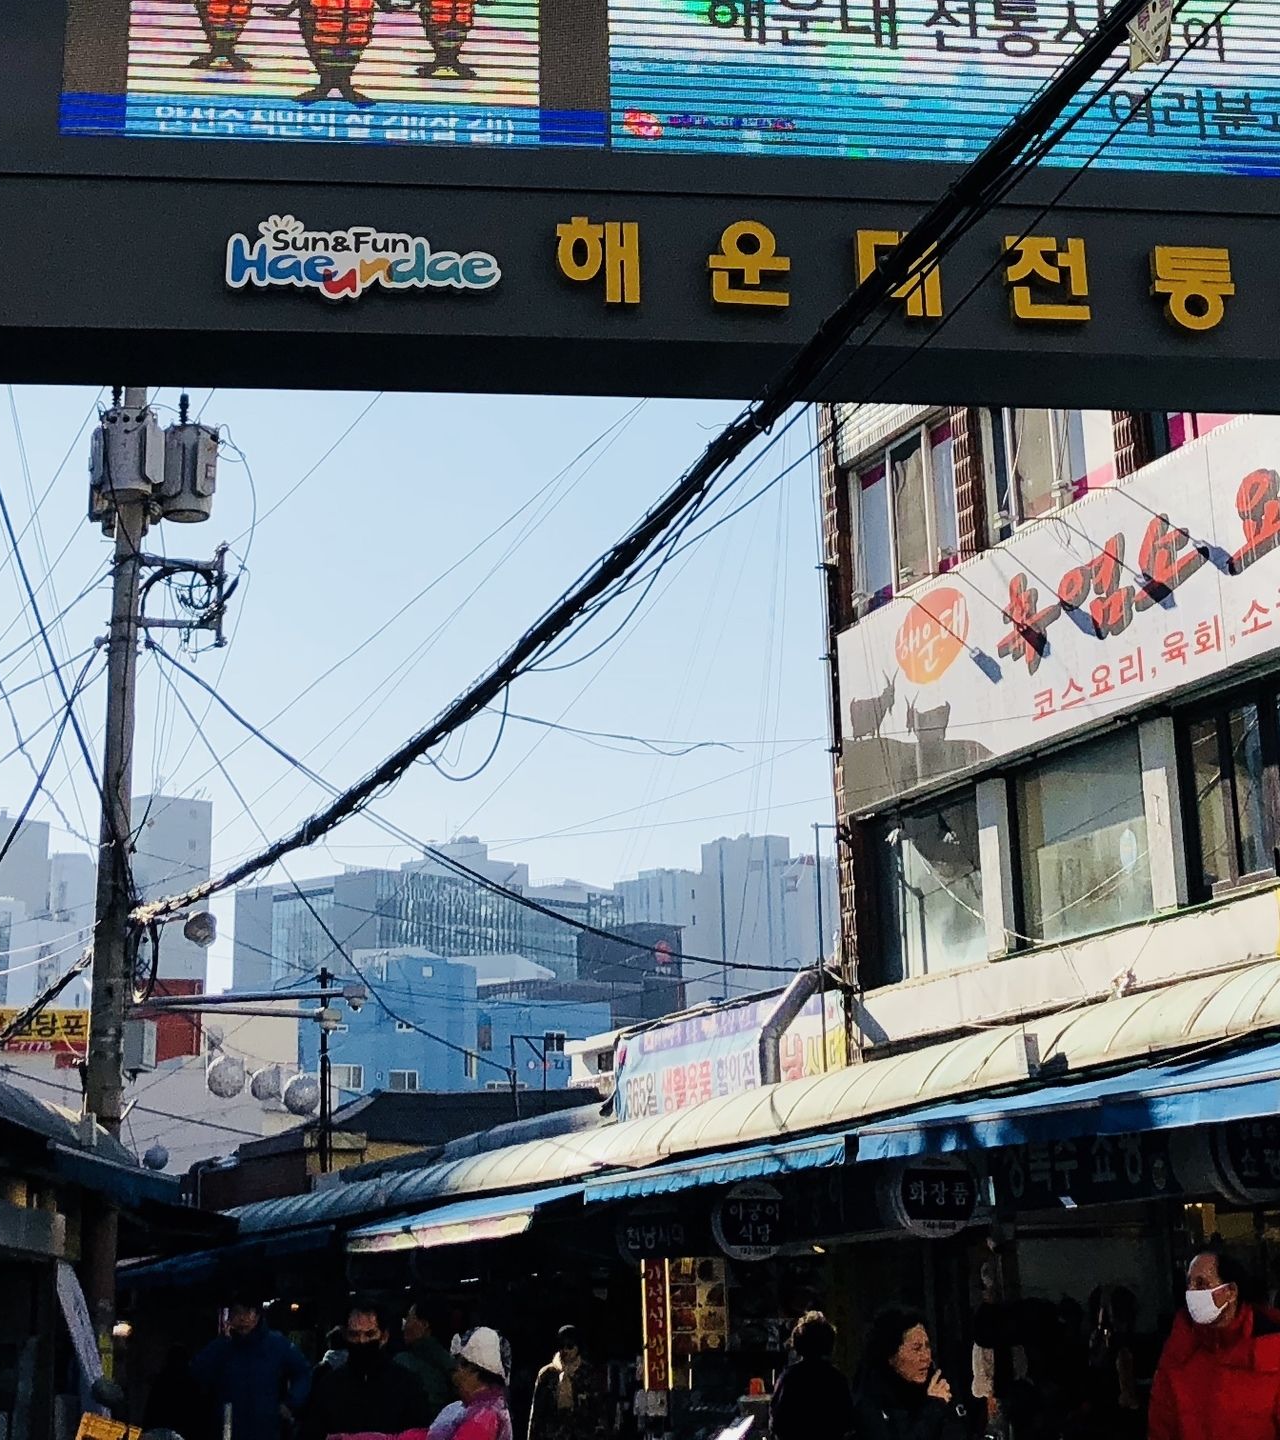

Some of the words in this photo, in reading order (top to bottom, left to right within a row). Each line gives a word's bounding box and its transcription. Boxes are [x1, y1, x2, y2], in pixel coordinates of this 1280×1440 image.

[272, 229, 410, 254] Sun&Fun
[230, 238, 498, 295] Haeundae
[898, 595, 967, 673] 해운대
[908, 1180, 968, 1206] 화장품
[738, 1222, 772, 1243] 식당
